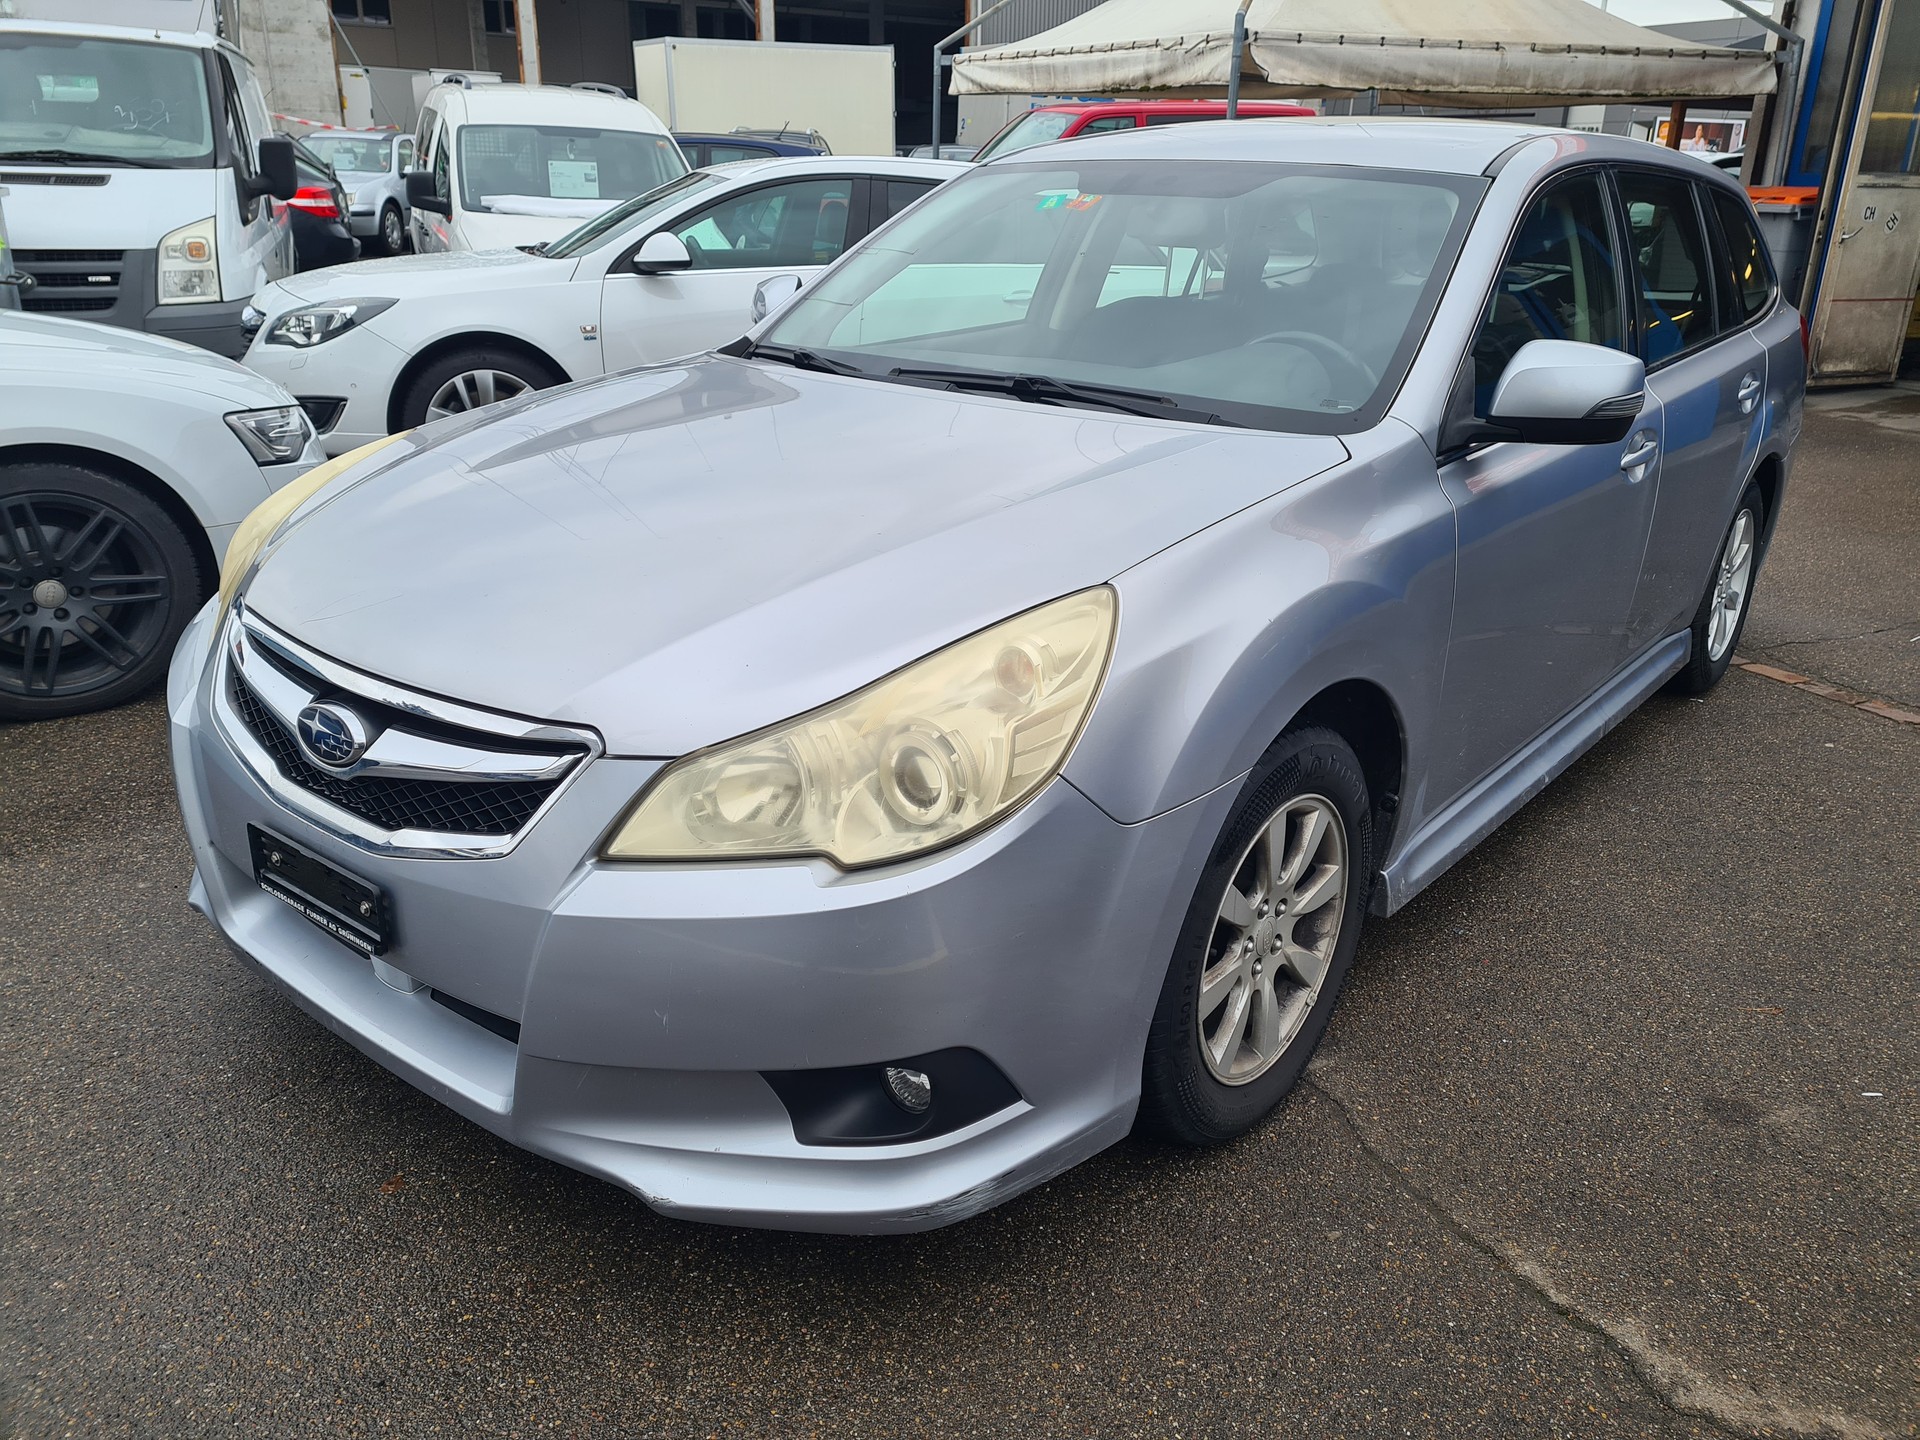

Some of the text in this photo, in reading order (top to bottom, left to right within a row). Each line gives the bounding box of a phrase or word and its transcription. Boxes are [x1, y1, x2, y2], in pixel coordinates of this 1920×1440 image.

[1864, 206, 1876, 220] CH
[1886, 213, 1898, 230] CH
[260, 882, 305, 913] SCHLOSSGARAGE
[306, 908, 328, 926] FURRER
[328, 922, 337, 932] AG
